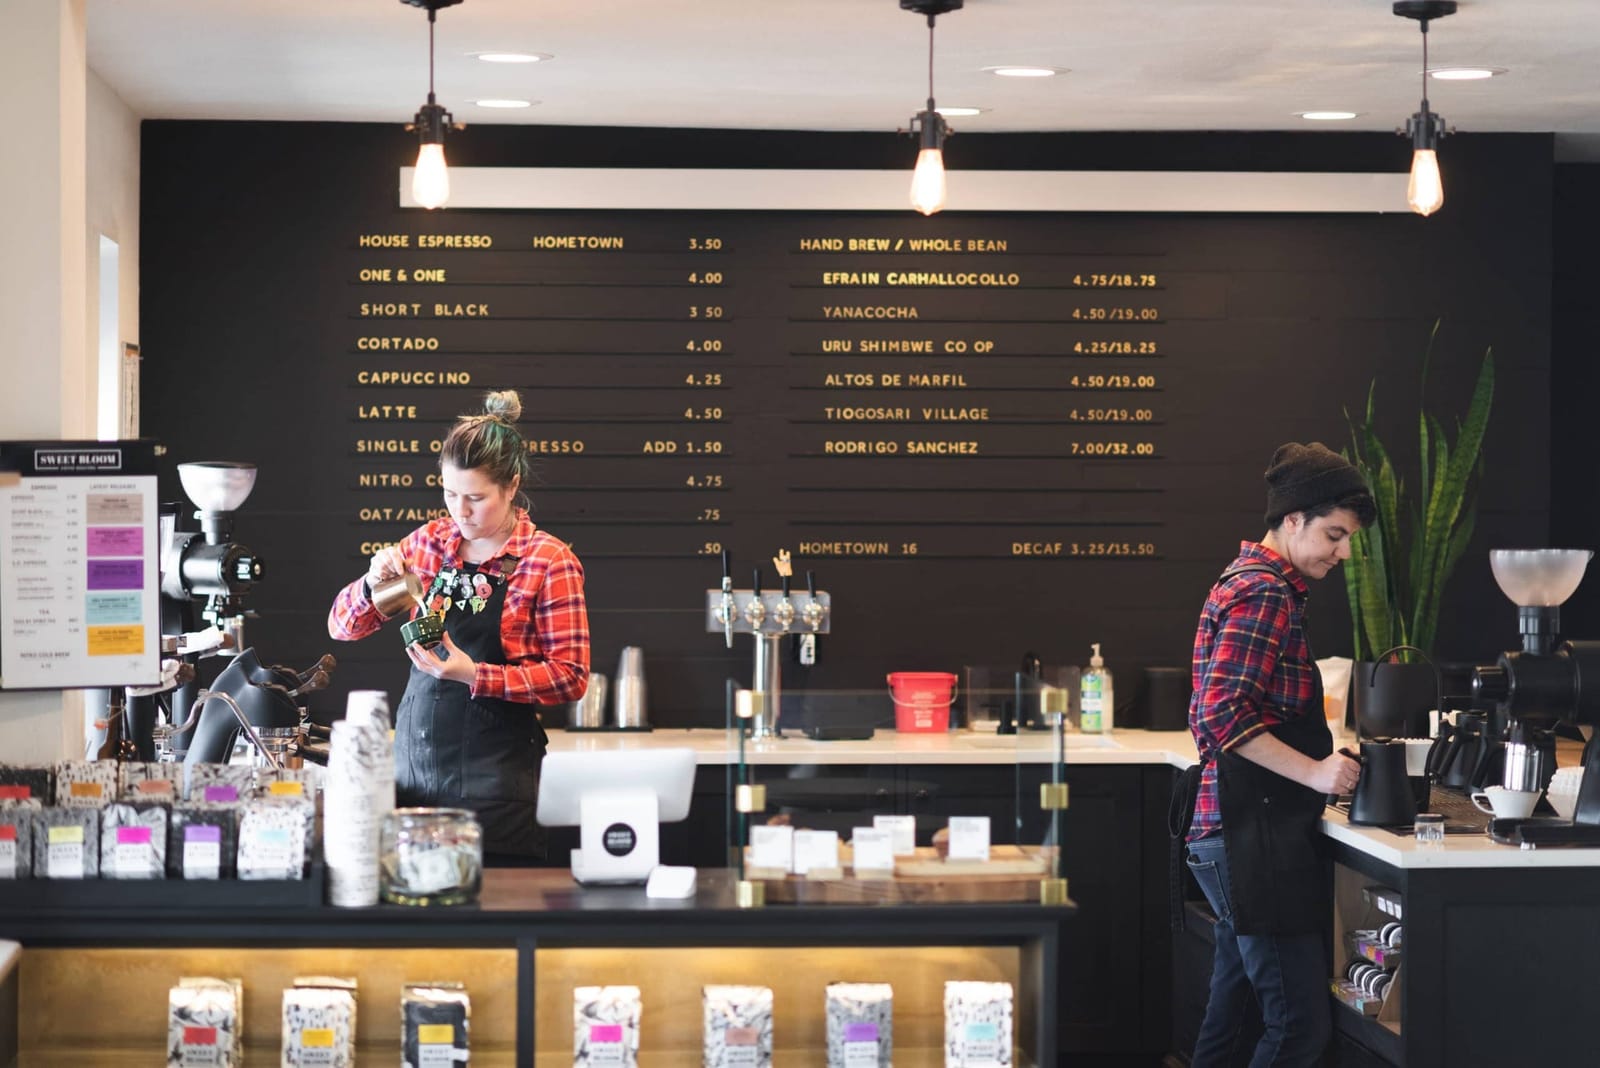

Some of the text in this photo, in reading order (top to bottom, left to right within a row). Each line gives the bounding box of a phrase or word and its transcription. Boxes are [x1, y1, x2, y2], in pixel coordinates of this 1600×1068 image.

[359, 234, 722, 250] HOUSE ESPRESSO HOMETOWN 3.50
[800, 239, 844, 251] HAND
[848, 239, 890, 251] BREW
[909, 240, 962, 252] WHOLE
[967, 240, 1007, 252] BEAN
[360, 269, 723, 285] ONE & ONE 4.00
[823, 272, 1156, 287] EFRAIN CARHALLOCOLLO 4.75/18.75
[360, 303, 421, 316] SHORT
[434, 303, 489, 316] BLACK
[823, 306, 918, 319] YANACOCHA
[358, 337, 722, 352] CORTADO 4.00
[822, 340, 1156, 354] URU SHIMBWE CO OP 4.25/18.25
[358, 371, 722, 386] CAPPUCCINO 4.25
[825, 373, 874, 387] ALTOS
[882, 374, 902, 387] DE
[909, 374, 967, 387] MARFIL
[359, 406, 723, 420] LATTE 4.50
[824, 407, 1153, 421] TIOGOSARI VILLAGE 4.50/19.00
[357, 440, 420, 453] SINGLE
[643, 441, 678, 454] ADD
[686, 441, 723, 454] 1.50
[825, 441, 1154, 455] RODRIGO SANCHEZ 7.00/32.00
[40, 454, 116, 465] SWEET BLOOM
[360, 474, 413, 487] NITRO
[686, 475, 722, 487] 4.75
[360, 508, 720, 520] OAT/ALMO .75
[697, 542, 722, 554] .50
[799, 542, 1154, 556] HOMETOWN 16 DECAF 3.25/15.50
